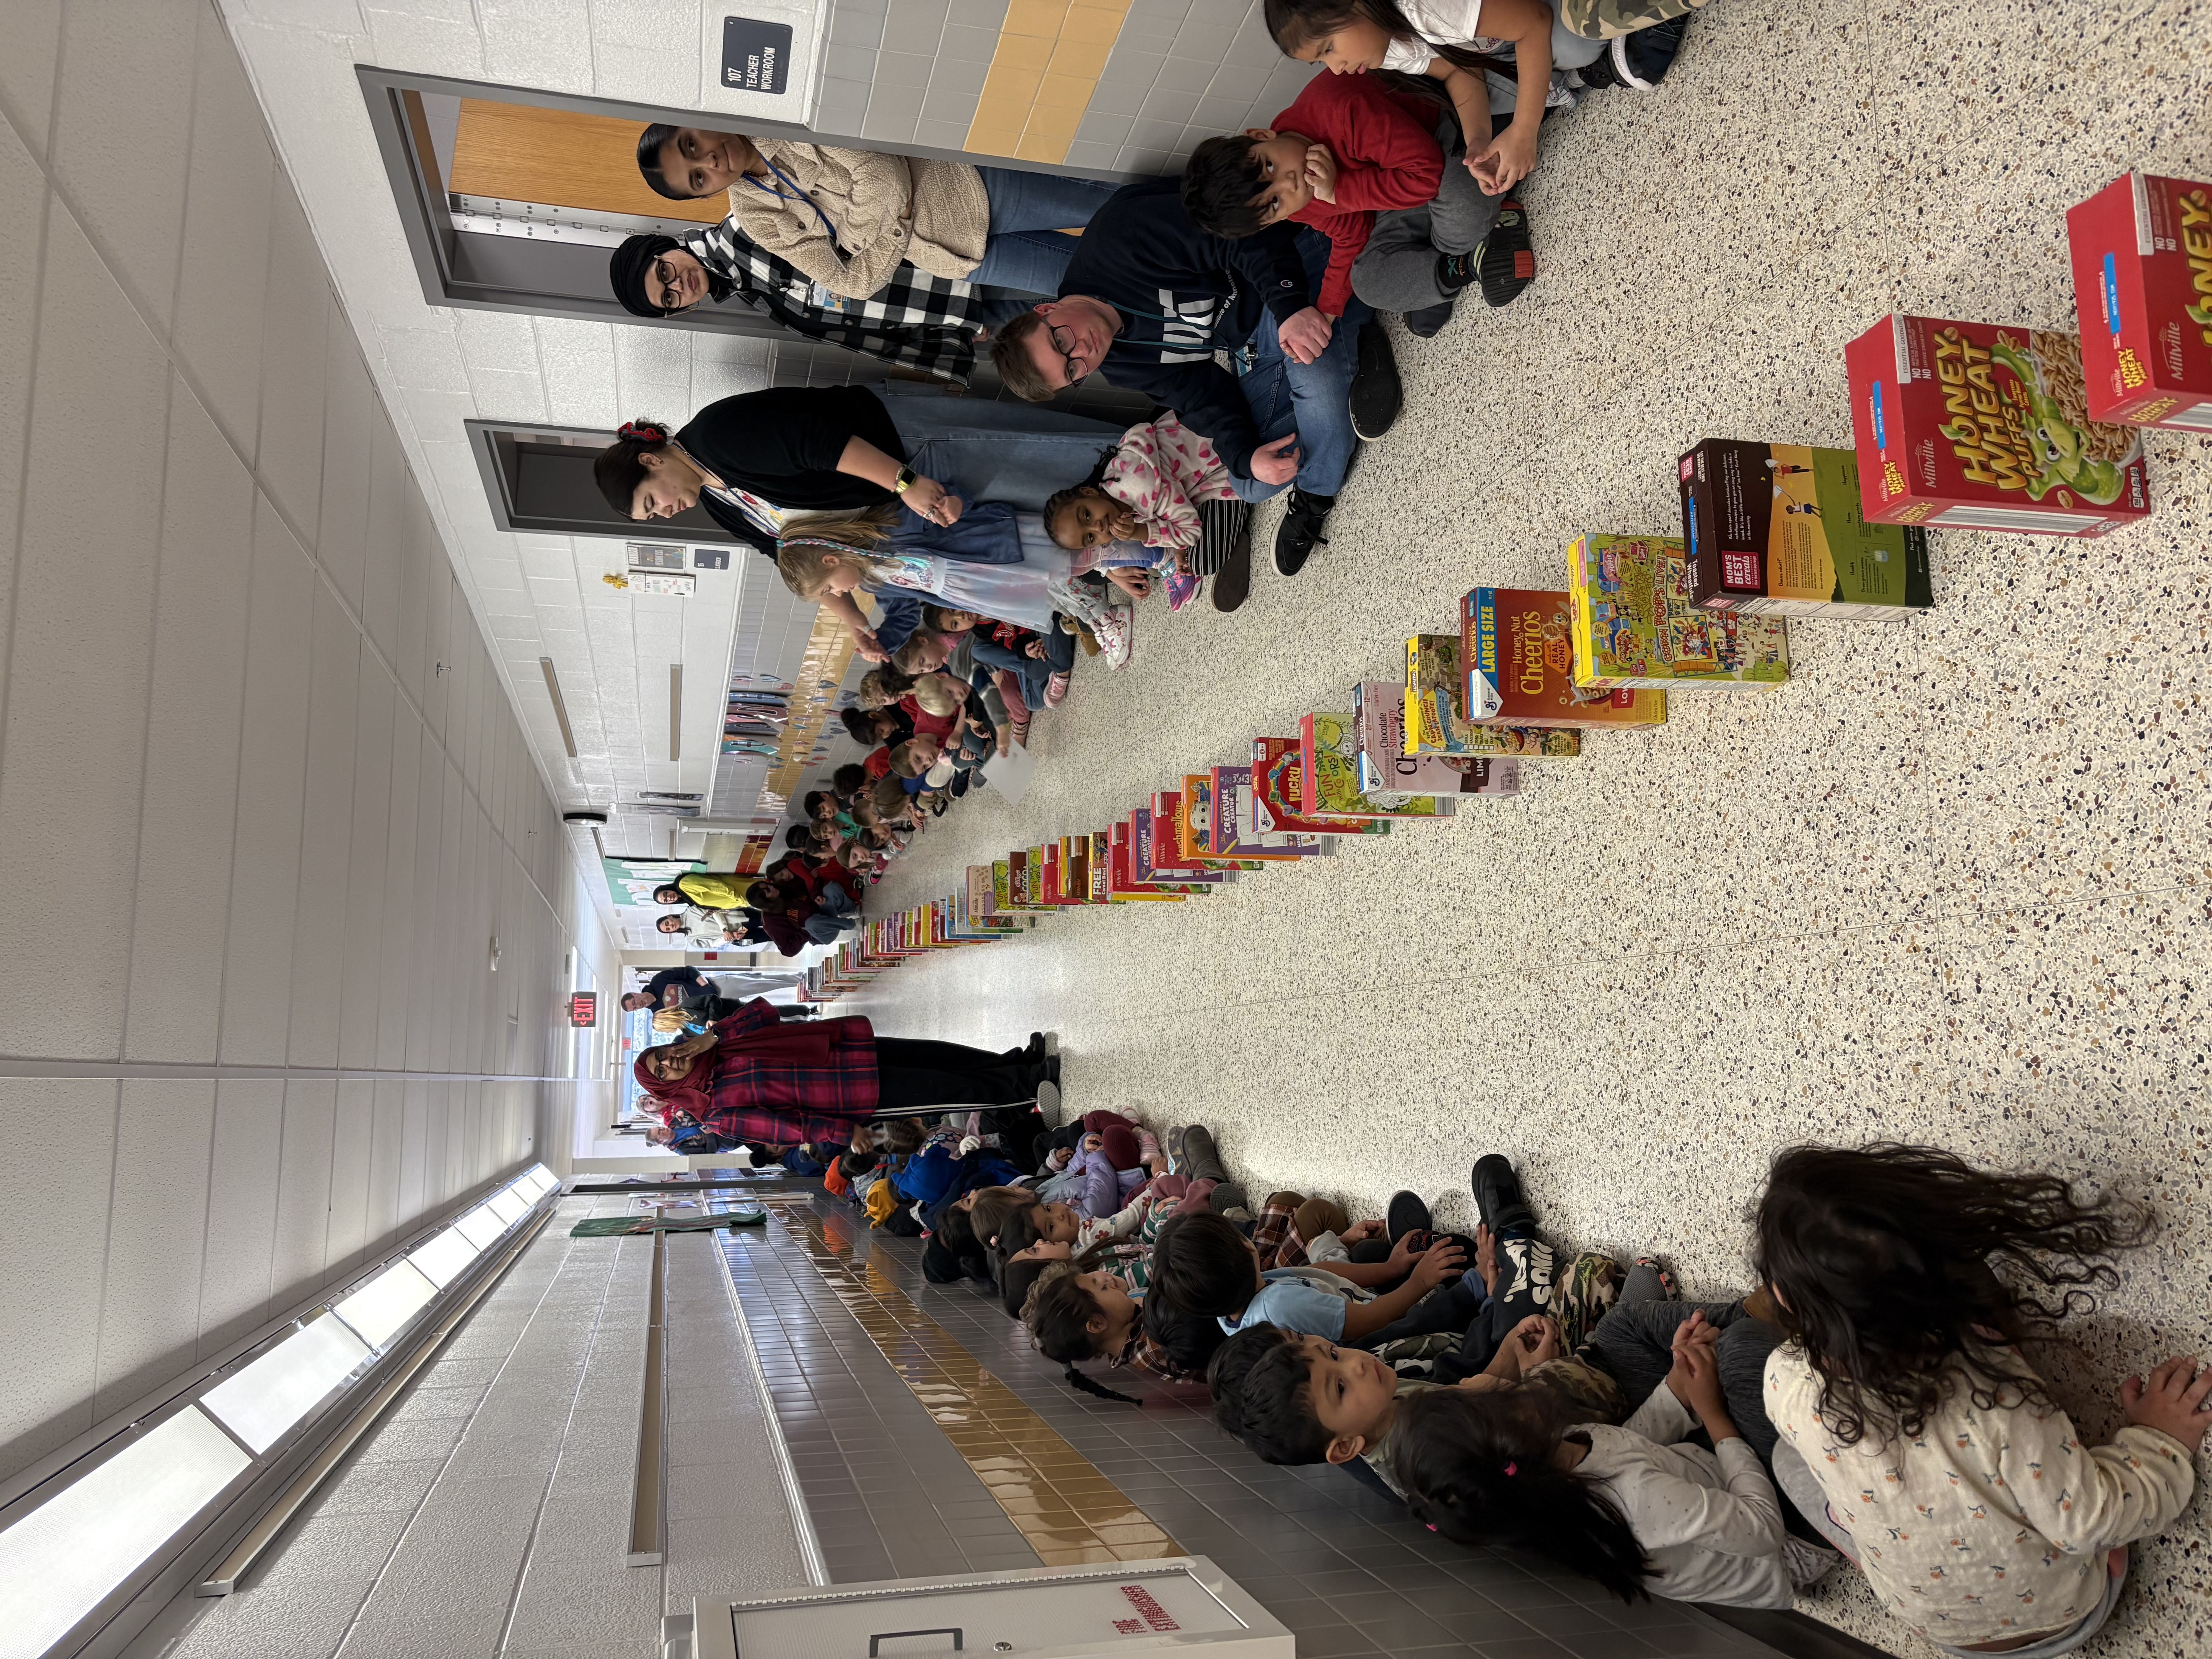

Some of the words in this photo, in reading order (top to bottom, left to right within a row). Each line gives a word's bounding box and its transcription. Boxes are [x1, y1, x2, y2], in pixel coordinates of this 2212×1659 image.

[727, 67, 742, 81] 107
[746, 55, 759, 87] TEACHER
[761, 46, 775, 89] WORKROOM
[2155, 237, 2165, 249] NO
[2166, 238, 2177, 251] NO
[1224, 299, 1231, 308] of
[2167, 322, 2183, 380] Millville
[1911, 368, 1921, 378] NO
[1922, 369, 1932, 379] NO
[2118, 350, 2135, 388] HONEY
[2126, 348, 2144, 386] WHEAT
[2136, 362, 2148, 379] PUFFS
[2114, 369, 2123, 396] Millville
[1934, 332, 1998, 486] HONEY
[1962, 338, 2028, 490] WHEAT
[2127, 397, 2170, 421] HONEY
[2002, 406, 2041, 478] PUFFS
[1889, 461, 1903, 493] WHEAT
[1922, 439, 1936, 488] Millville
[1884, 463, 1897, 495] HONEY
[1897, 472, 1906, 487] PUFFS
[1896, 502, 1926, 521] HONEY
[1904, 503, 1935, 522] WHEAT
[1654, 556, 1666, 584] LIVE!
[1725, 555, 1734, 583] MOM'S
[1733, 555, 1743, 584] BEST
[1742, 556, 1751, 584] cereals
[1481, 606, 1494, 631] SIZE
[1652, 587, 1666, 626] POPS
[1511, 616, 1520, 632] Nut
[1481, 634, 1495, 672] LARGE
[1512, 637, 1523, 663] Honey
[1520, 611, 1544, 694] Cheerios
[1659, 629, 1672, 661] CORN
[1422, 699, 1431, 723] CRUNCH
[1429, 700, 1439, 725] LAFOOTE!
[1378, 713, 1388, 748] Chocolate
[1387, 709, 1398, 748] Strawberry
[1320, 774, 1335, 797] FUN
[1221, 789, 1231, 833] CREATURE
[1140, 829, 1149, 866] CREATURE
[1093, 868, 1101, 895] FREE
[574, 997, 594, 1021] EXIT
[1120, 1585, 1181, 1631] EXTINGUISHER
[1111, 1619, 1148, 1635] FIRE
